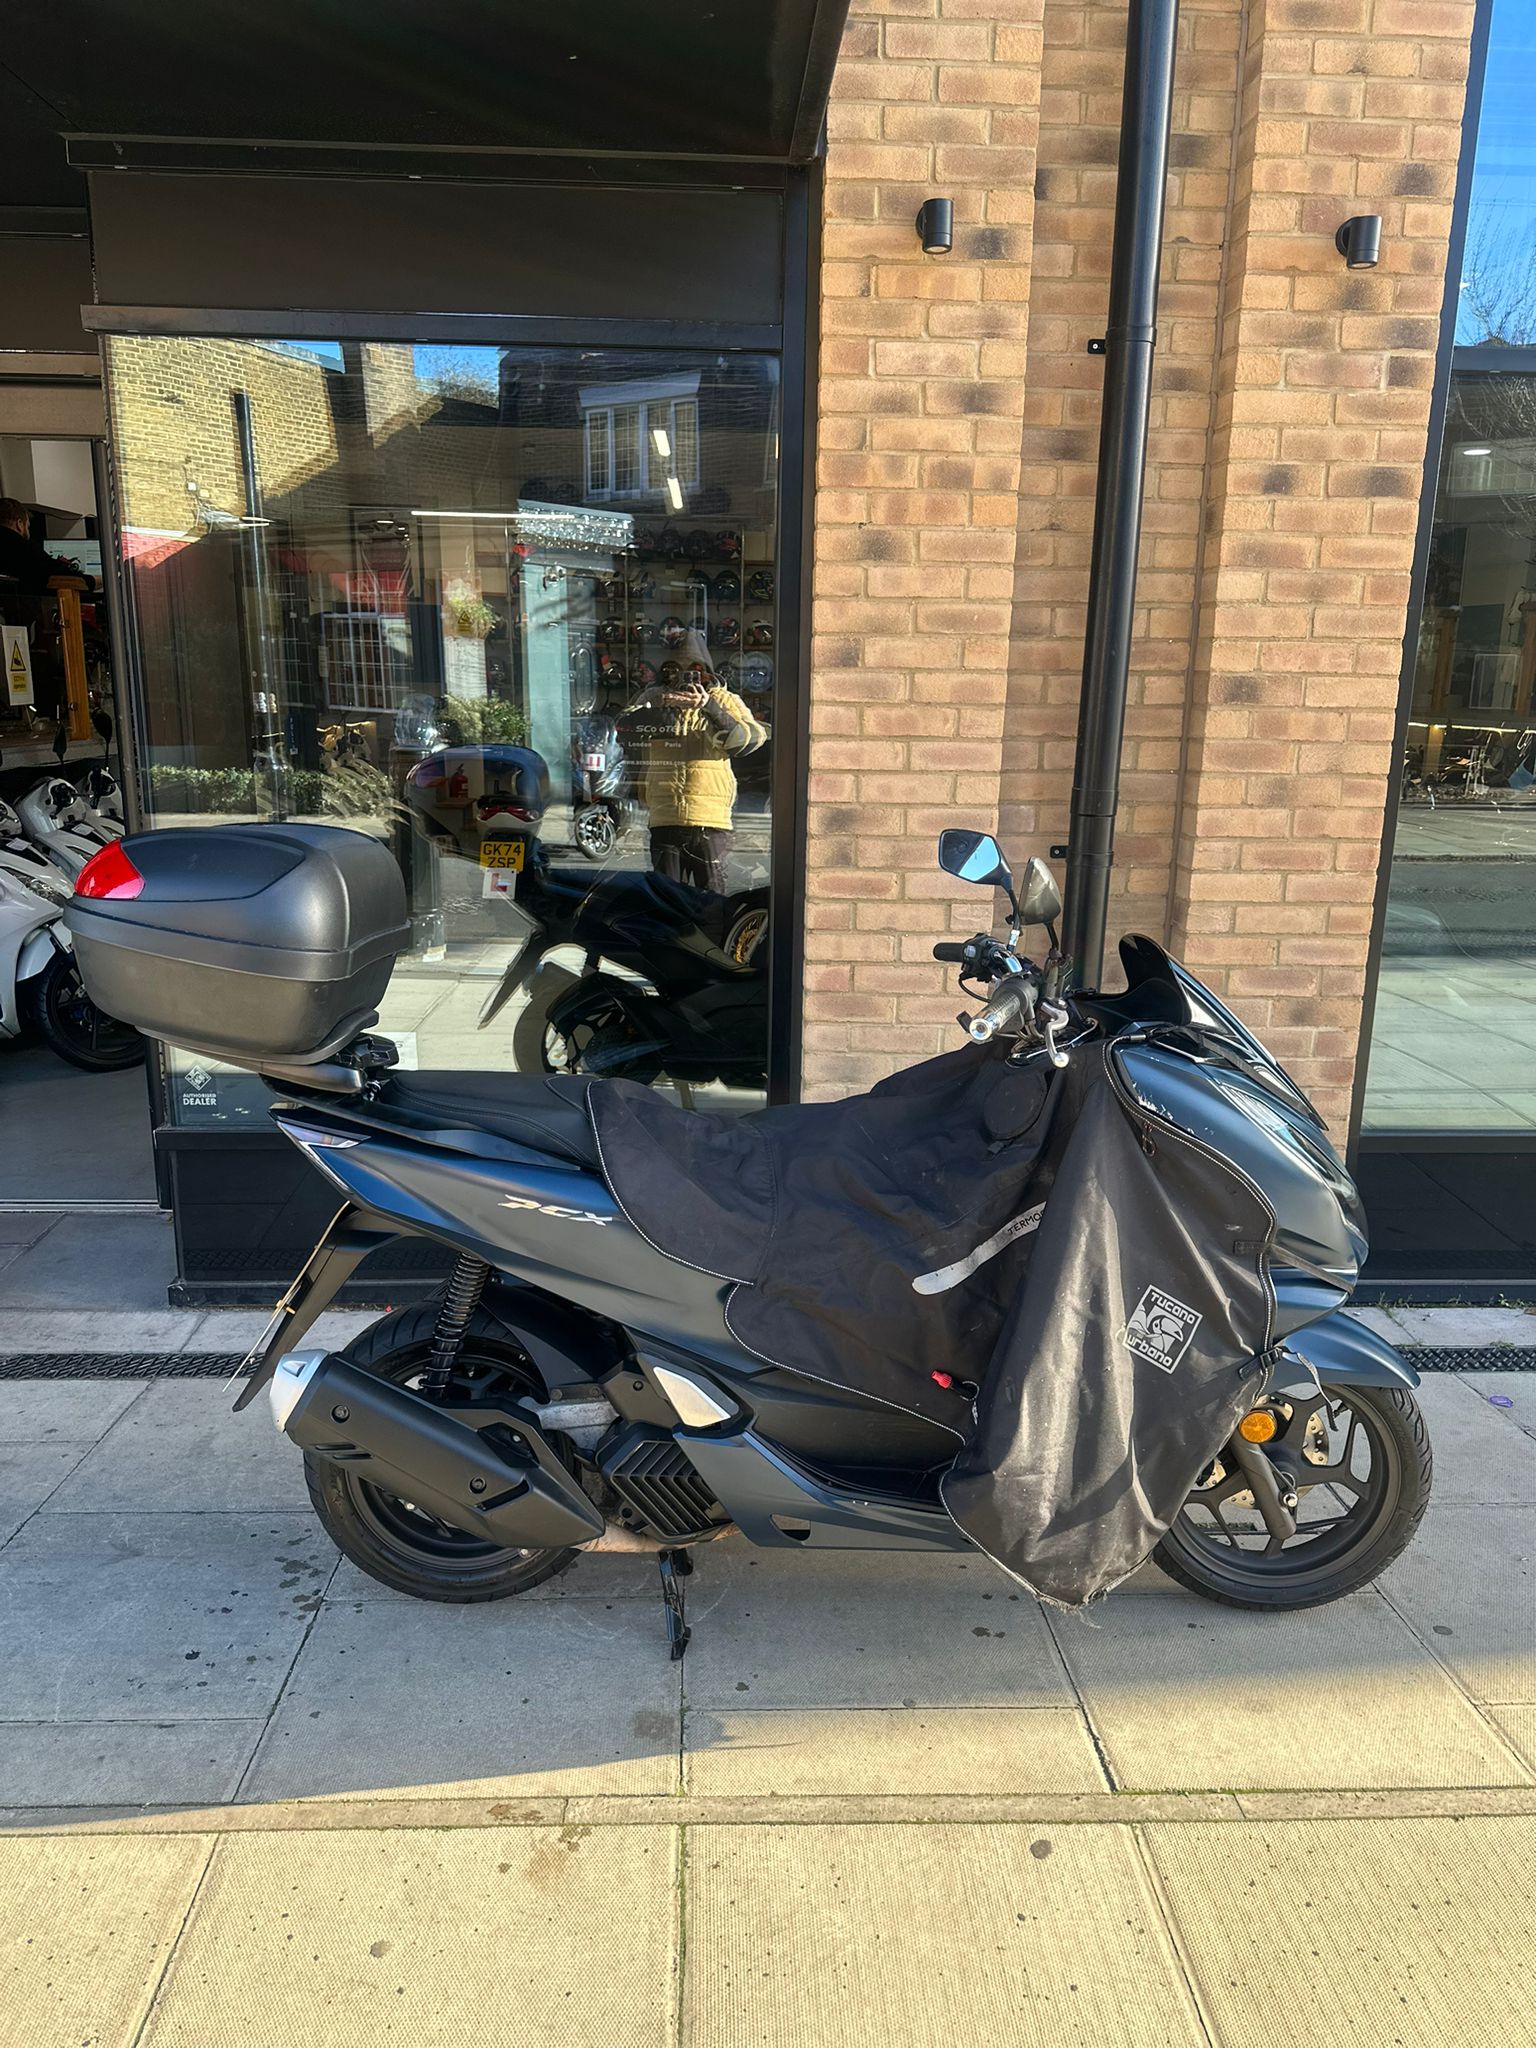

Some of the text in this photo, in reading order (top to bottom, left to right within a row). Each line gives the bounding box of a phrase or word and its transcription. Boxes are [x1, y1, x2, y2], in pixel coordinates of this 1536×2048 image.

[483, 843, 522, 856] GK74
[487, 857, 516, 868] ZSP
[183, 1098, 217, 1106] DEALER
[498, 1194, 613, 1226] PCX
